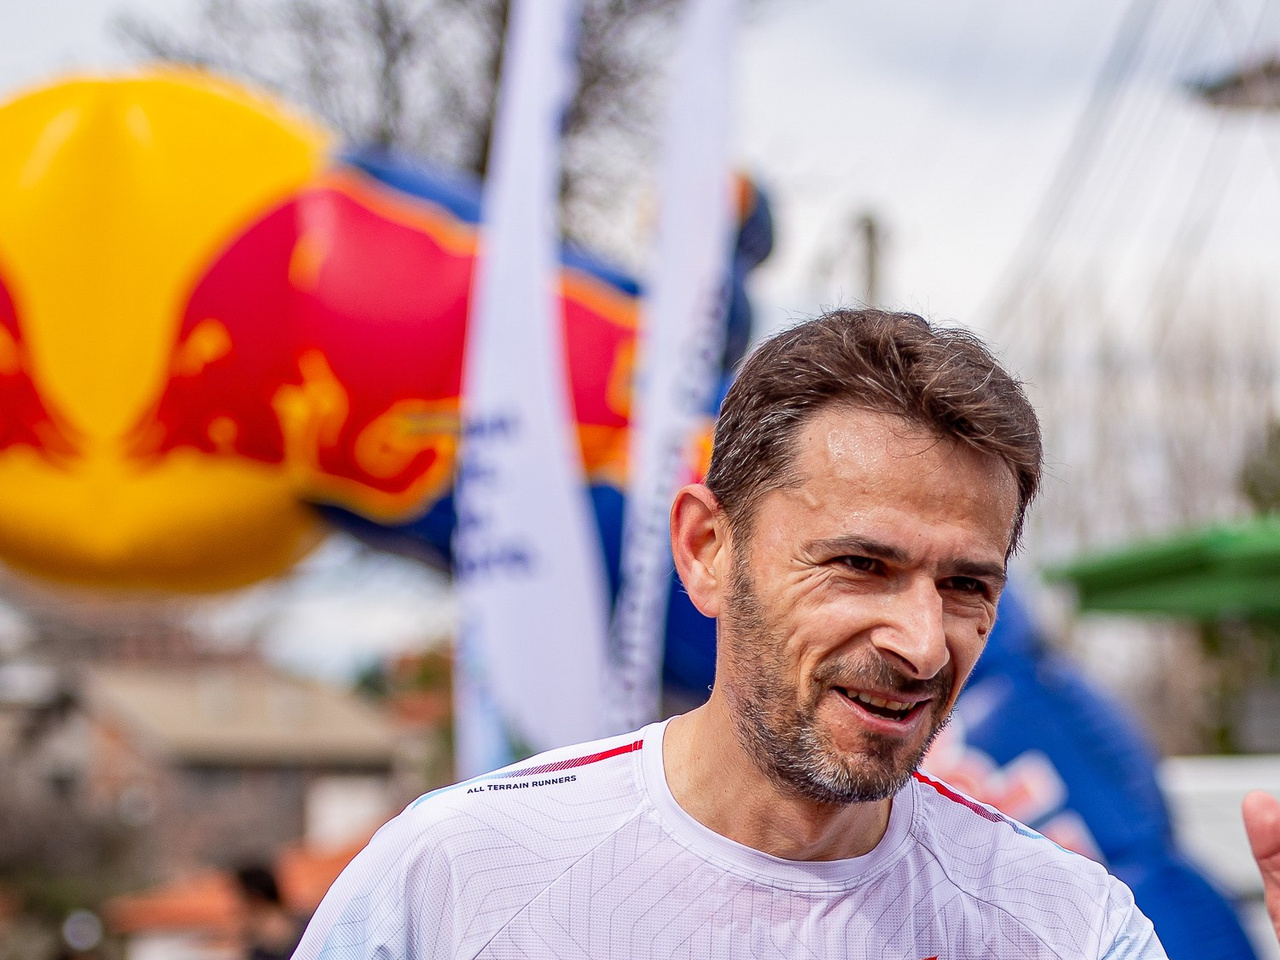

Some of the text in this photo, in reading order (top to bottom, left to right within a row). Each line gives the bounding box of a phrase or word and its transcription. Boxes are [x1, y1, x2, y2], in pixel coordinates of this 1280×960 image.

[467, 775, 577, 794] ALL TERRAIN RUNNERS
